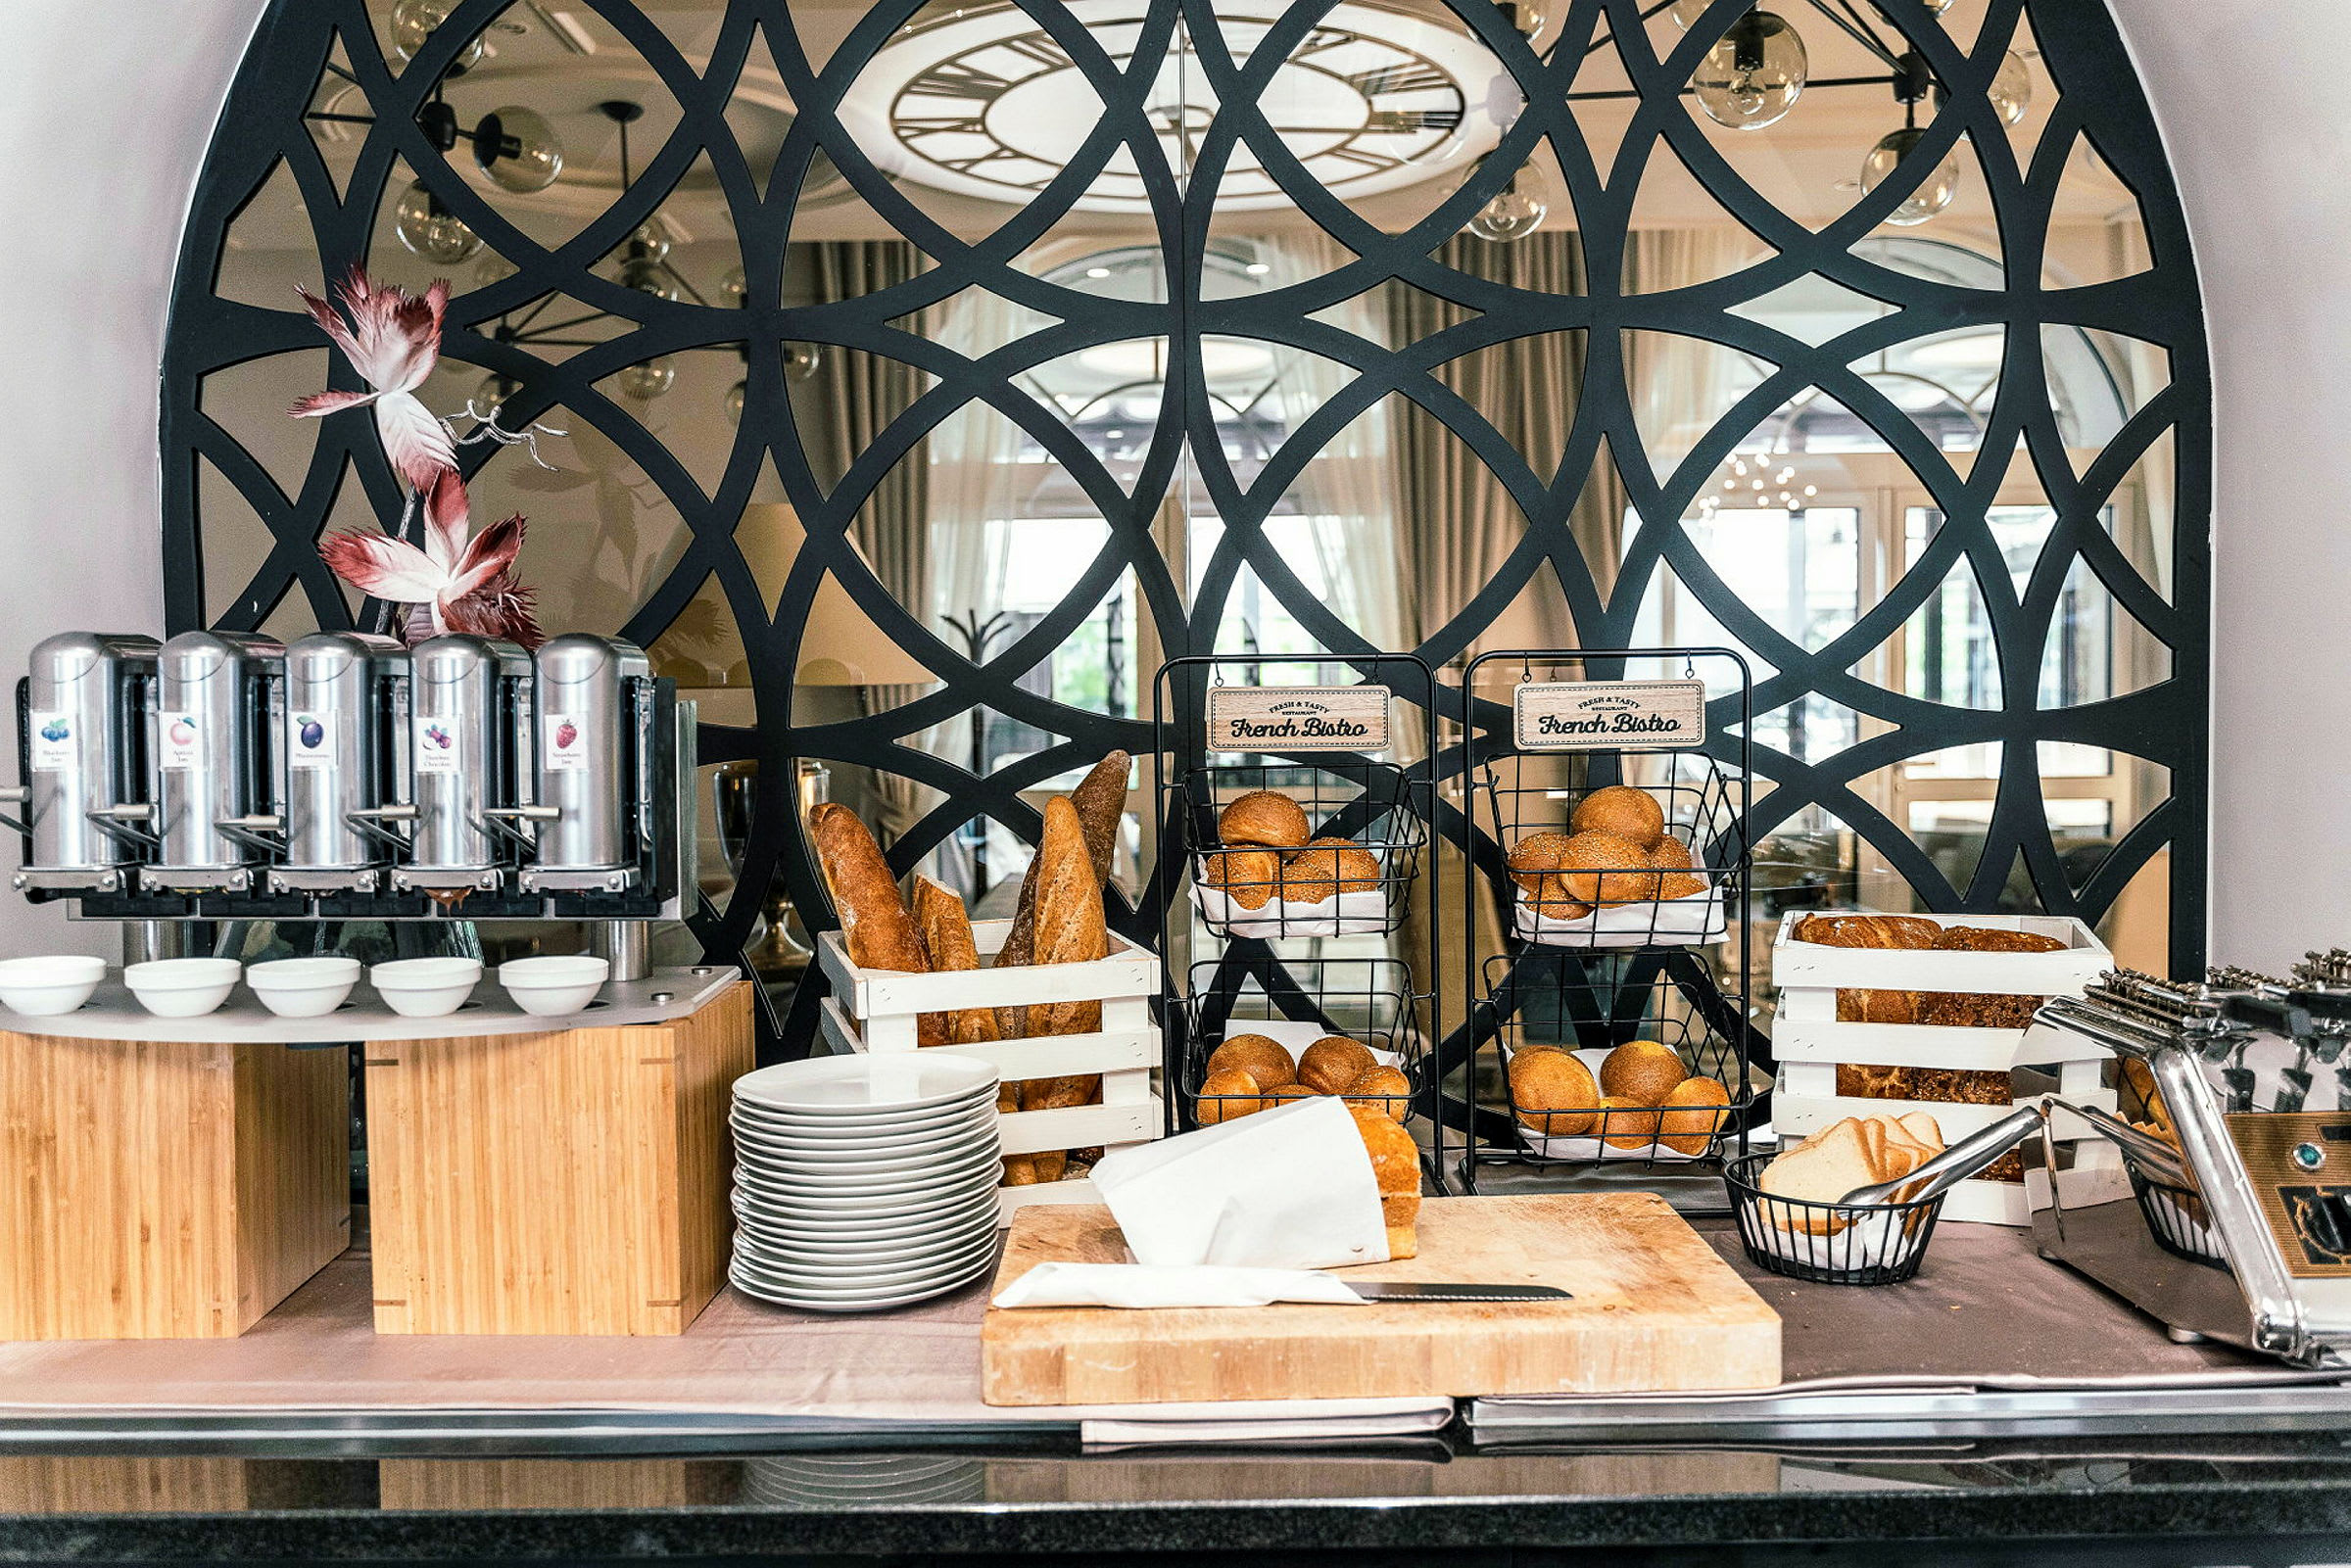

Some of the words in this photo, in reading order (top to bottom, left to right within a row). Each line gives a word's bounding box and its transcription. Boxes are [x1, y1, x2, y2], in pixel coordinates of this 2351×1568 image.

[1269, 701, 1294, 713] FRESH
[1305, 701, 1330, 714] TASTY
[1578, 696, 1604, 709] FRESH
[1614, 696, 1641, 709] TASTY
[1230, 718, 1300, 737] French
[1301, 717, 1368, 737] Bistro
[1538, 713, 1609, 735] French
[1611, 713, 1681, 733] Bistro
